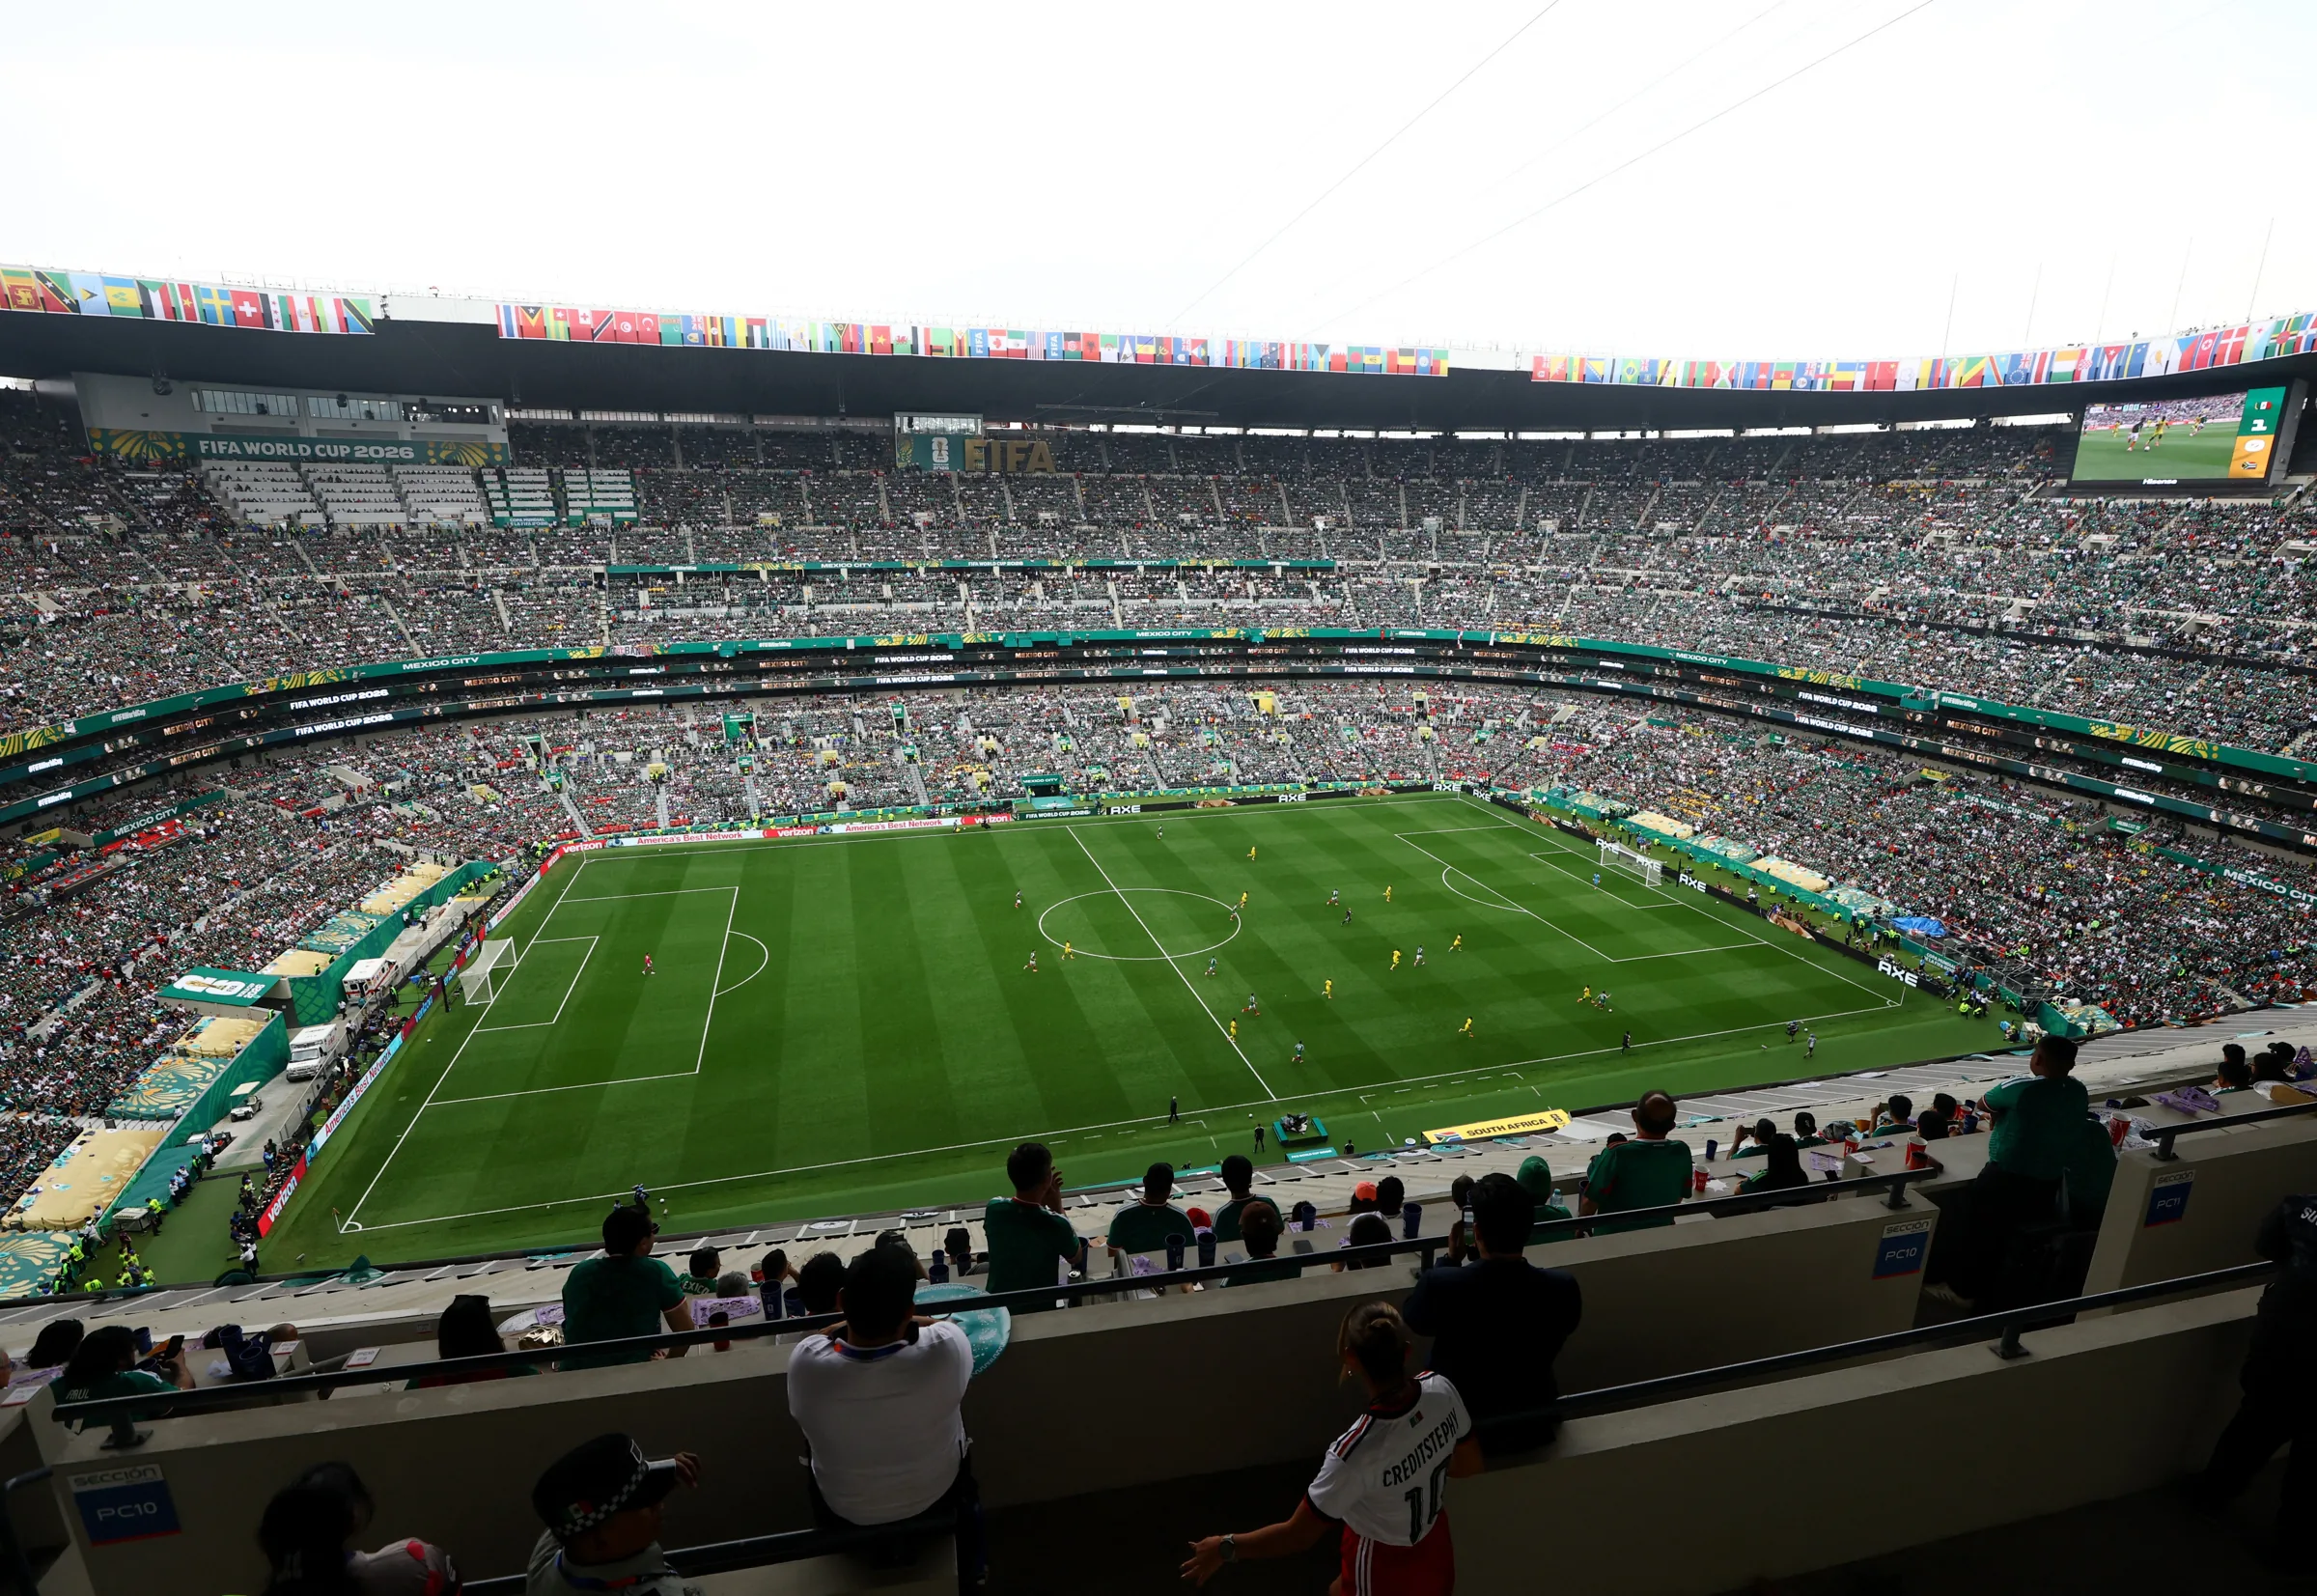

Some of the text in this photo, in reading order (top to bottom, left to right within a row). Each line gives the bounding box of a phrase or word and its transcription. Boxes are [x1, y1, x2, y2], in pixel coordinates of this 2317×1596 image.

[2251, 419, 2268, 432] 1
[199, 440, 414, 460] FIFA WORLD CUP 2026
[964, 439, 1056, 472] FIFA
[403, 657, 480, 670] MEXICO CITY
[1675, 652, 1728, 665] MEXICO CITY
[464, 675, 522, 686] MEXICO CITY
[1699, 674, 1742, 686] MEXICO CITY
[290, 688, 389, 710] FIFA WORLD CUP 2026
[468, 700, 503, 710] MEXICO
[1697, 695, 1738, 709] MEXICO CITY
[1798, 691, 1878, 713] FIFA WORLD CUP 2026
[1941, 696, 1978, 709] #FIFAWorldCup
[195, 717, 215, 728] CITY
[294, 714, 394, 736] FIFA WORLD CUP 2026
[1795, 715, 1874, 738] FIFA WORLD CUP 2026
[1946, 719, 2004, 738] MEXICO CITY
[169, 746, 221, 767] MEXICO CITY
[1821, 756, 1844, 768] CITY
[1941, 746, 1998, 766] MEXICO CITY
[1278, 794, 1306, 803] AXE
[1472, 789, 1491, 802] AXE
[1965, 795, 1979, 804] FIFA
[1110, 805, 1141, 814] AXE
[114, 806, 179, 837] MEXICO CITY
[845, 824, 886, 832] America's
[907, 818, 942, 827] Network
[974, 815, 1008, 824] verizon
[637, 831, 742, 845] America's Best Network
[777, 827, 814, 837] verizon
[563, 841, 602, 854] verizon
[1596, 837, 1620, 854] AXE
[1635, 854, 1662, 872] AXE
[1679, 873, 1707, 893] AXE
[2222, 868, 2287, 894] MEXICO
[443, 964, 458, 987] erizon
[1878, 960, 1918, 988] AXE
[324, 1047, 392, 1137] America's Best Network
[1466, 1118, 1549, 1136] SOUTH AFRICA
[267, 1175, 297, 1223] verizon
[2156, 1196, 2181, 1209] PC11
[1884, 1246, 1917, 1262] PC10
[683, 1280, 711, 1295] EXICO
[1382, 1407, 1459, 1488] CREDITSTEPHY
[96, 1501, 158, 1523] PC10
